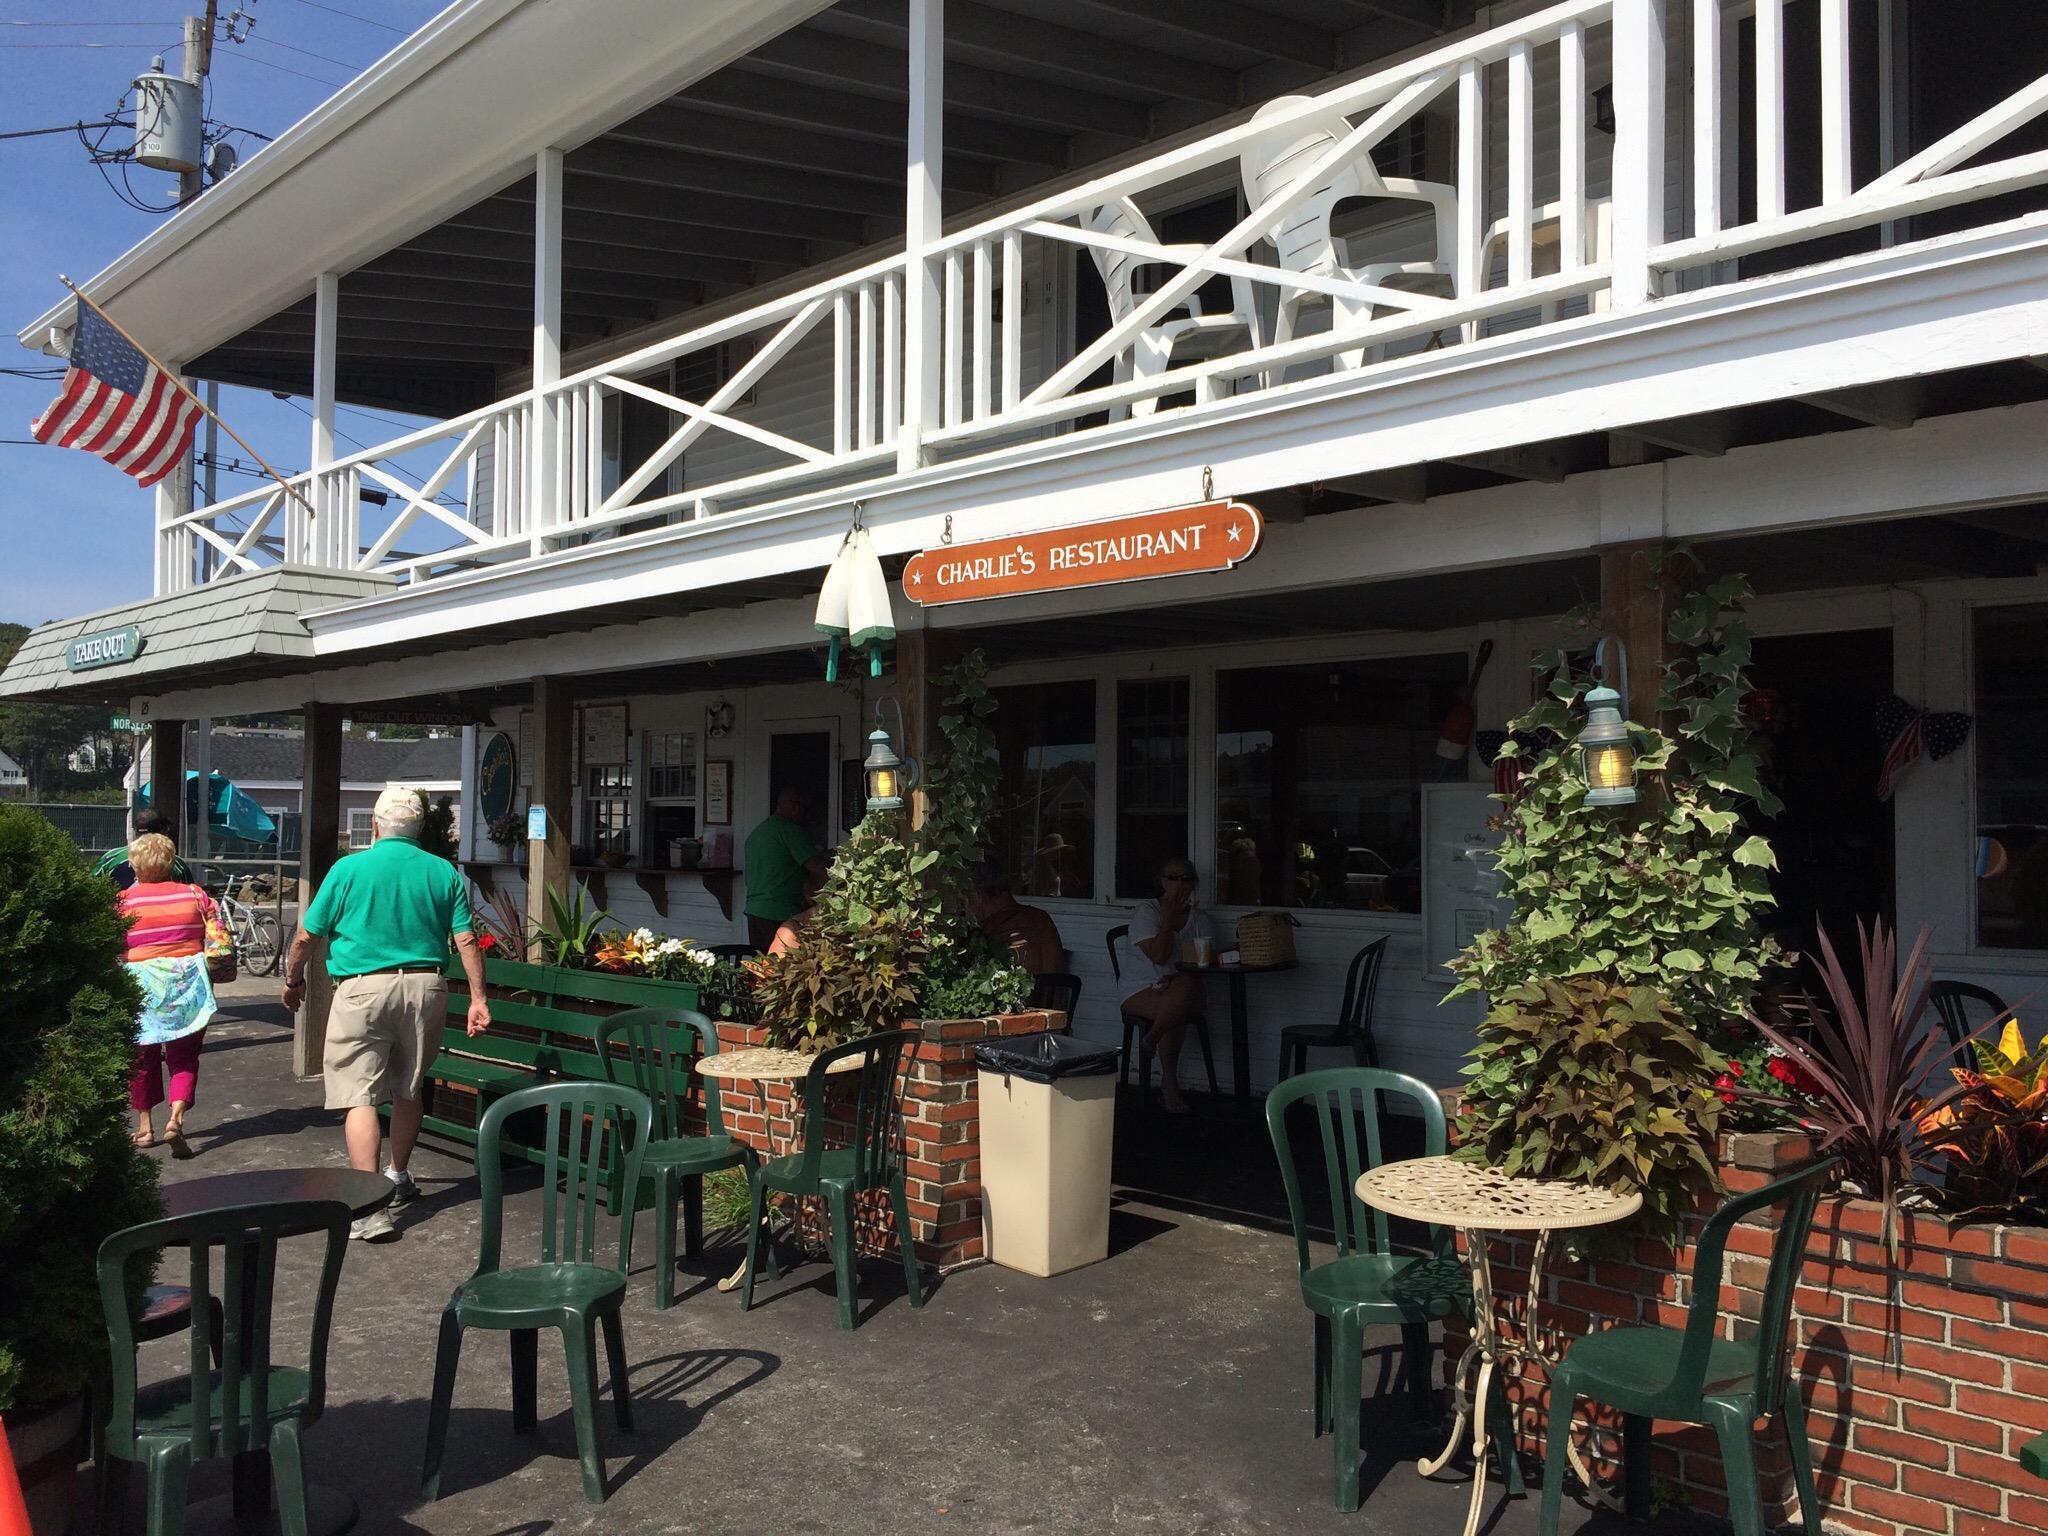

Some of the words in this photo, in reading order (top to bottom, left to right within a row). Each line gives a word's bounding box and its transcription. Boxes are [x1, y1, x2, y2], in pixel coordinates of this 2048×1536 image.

[937, 545, 1036, 586] CHARLIE'S
[1049, 524, 1207, 571] RESTAURANT
[75, 639, 102, 663] TAKE
[103, 633, 127, 658] OUT
[357, 711, 385, 722] TAKE
[387, 711, 412, 722] OUT
[414, 712, 473, 724] WINDOW
